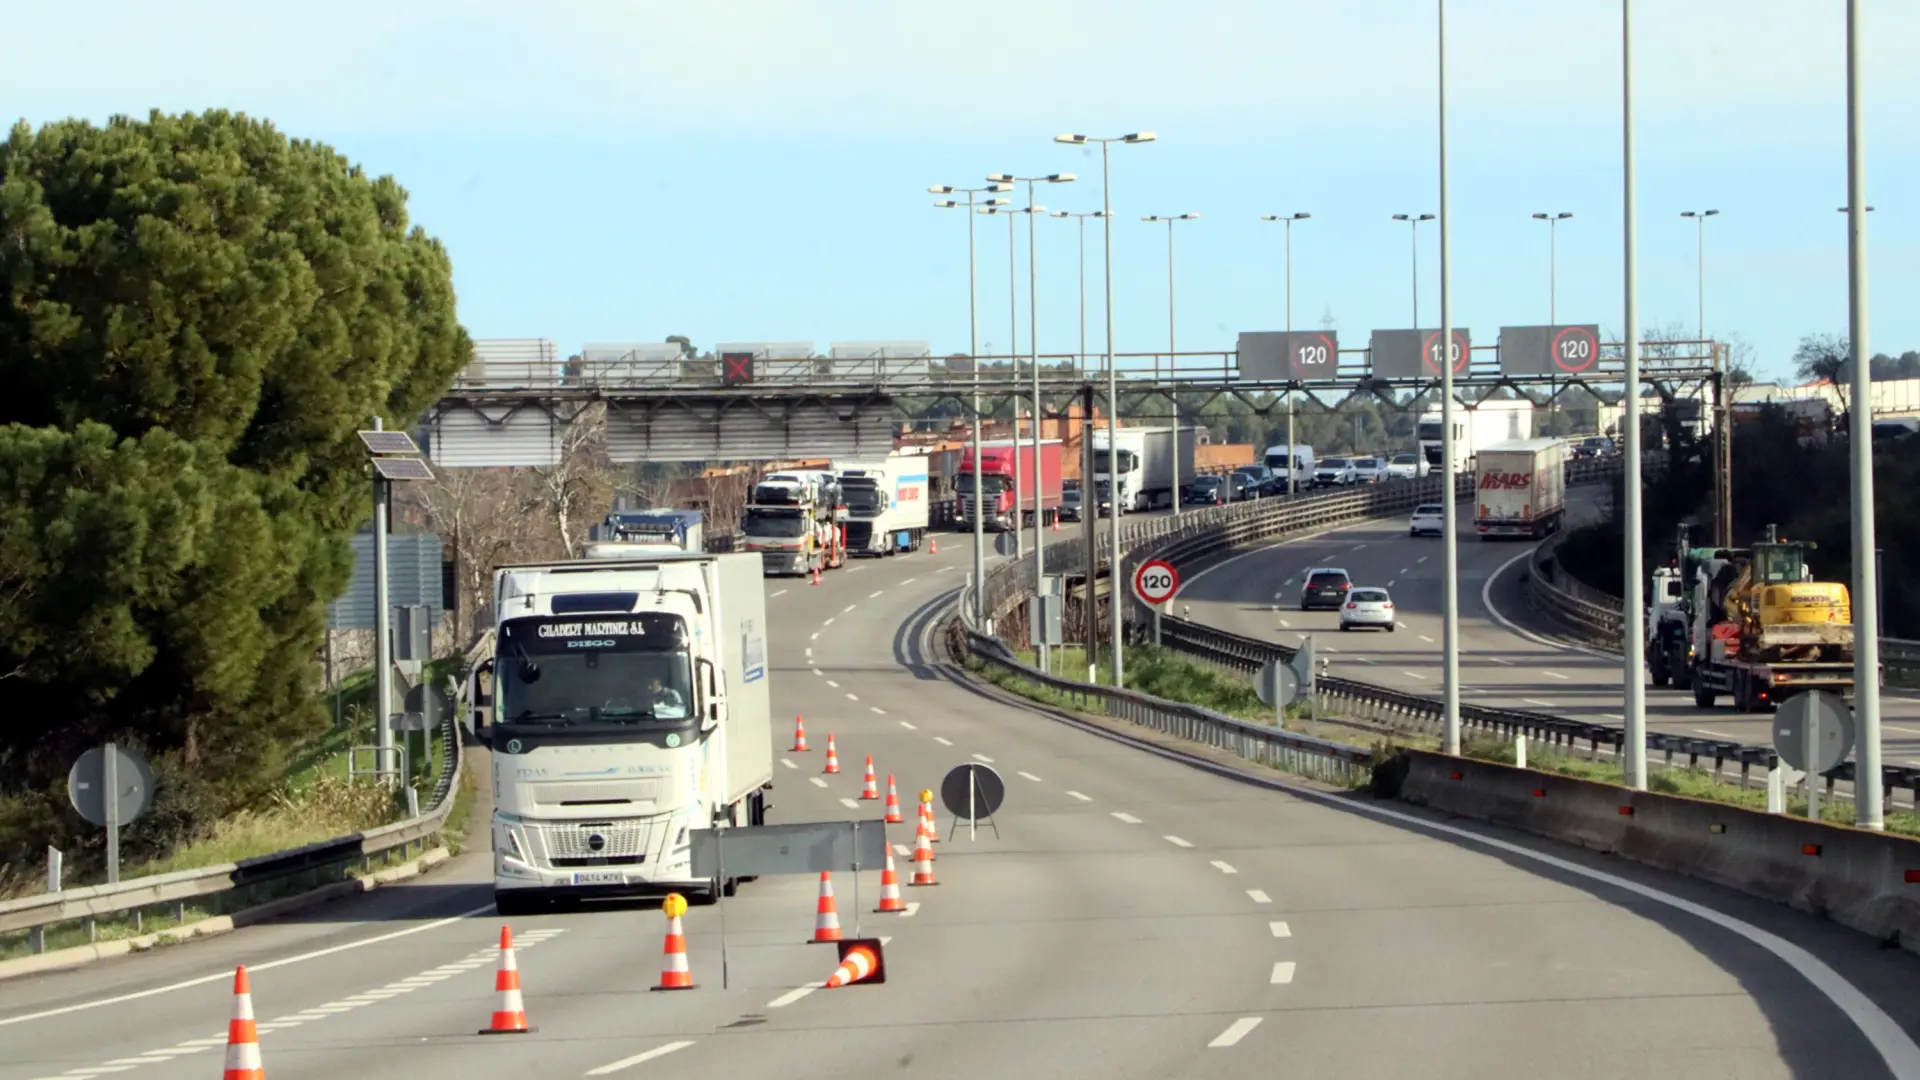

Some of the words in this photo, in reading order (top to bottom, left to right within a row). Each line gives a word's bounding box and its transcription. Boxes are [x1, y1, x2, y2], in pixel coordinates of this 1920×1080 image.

[1299, 346, 1327, 364] 120
[1431, 343, 1460, 361] 10
[1560, 340, 1589, 358] 120
[1143, 574, 1171, 589] 120
[538, 623, 583, 638] GILABERT
[584, 621, 629, 636] MARTINEZ
[567, 639, 616, 648] DIEGO
